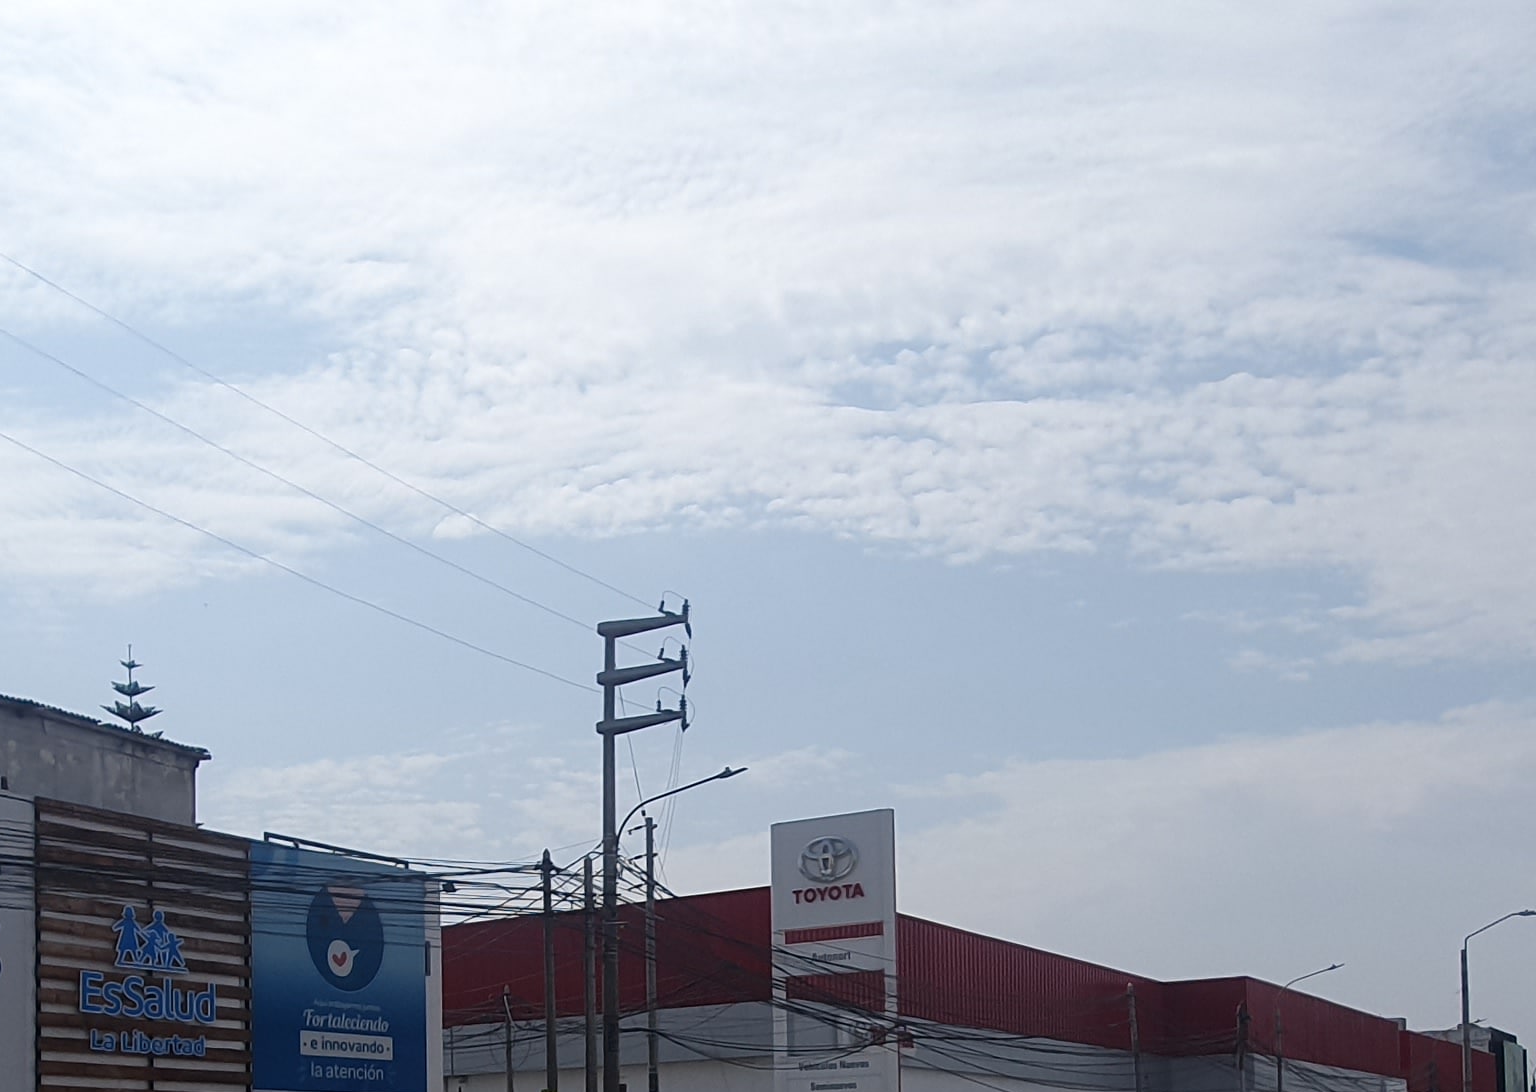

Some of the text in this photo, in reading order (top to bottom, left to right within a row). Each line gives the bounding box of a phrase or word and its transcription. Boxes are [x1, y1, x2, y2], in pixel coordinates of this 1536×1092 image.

[792, 883, 865, 904] TOYOTA
[80, 970, 216, 1024] EsSalud
[303, 1009, 390, 1033] Fortaleciendo
[90, 1028, 206, 1057] La Libertad
[310, 1035, 385, 1054] e innovando
[311, 1062, 384, 1081] la atención
